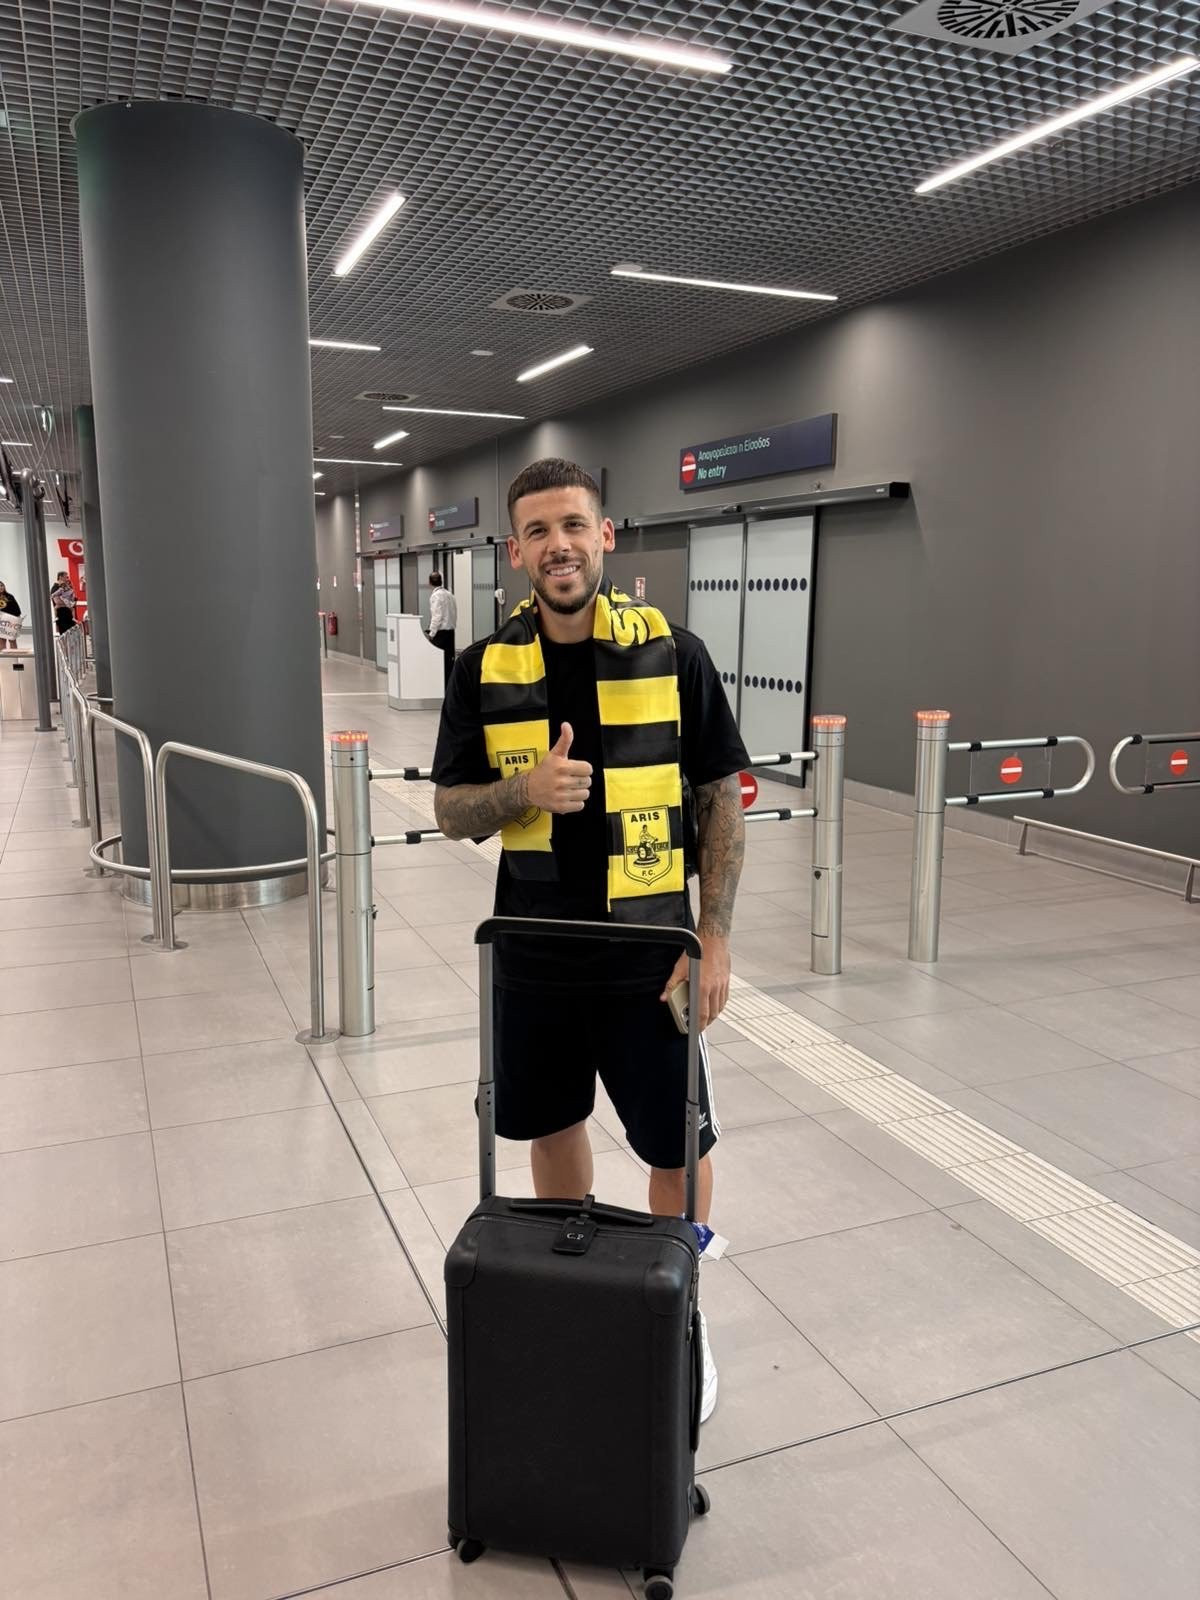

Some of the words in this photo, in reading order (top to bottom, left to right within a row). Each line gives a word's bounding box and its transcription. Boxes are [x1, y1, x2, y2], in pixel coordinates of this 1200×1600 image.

[697, 468, 707, 480] No
[708, 465, 727, 479] entry
[505, 754, 529, 765] ARIS
[630, 811, 660, 823] ARIS
[641, 869, 656, 877] F.C.
